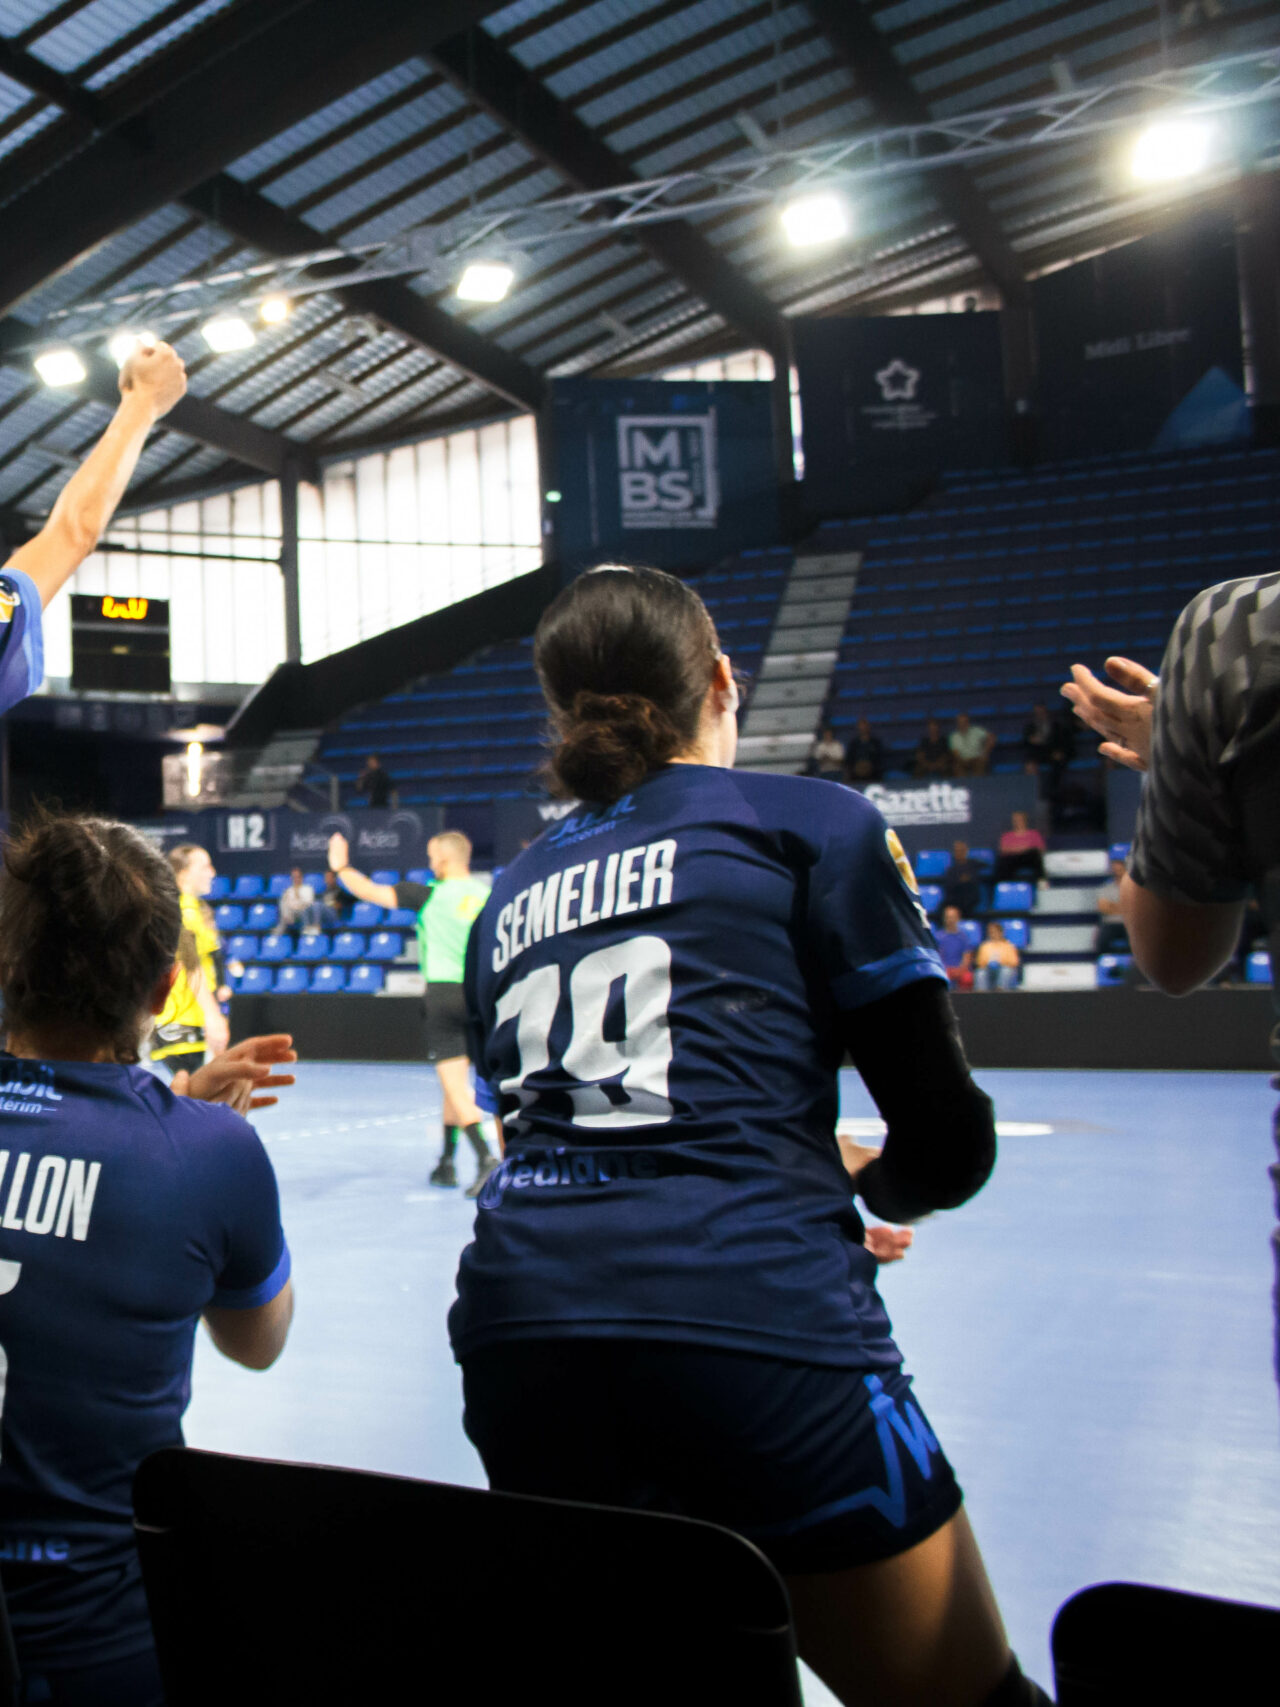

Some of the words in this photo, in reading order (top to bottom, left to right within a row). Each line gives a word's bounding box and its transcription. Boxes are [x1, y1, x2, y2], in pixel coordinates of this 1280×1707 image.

[620, 470, 694, 510] BS
[864, 784, 969, 813] Gazette
[492, 838, 678, 974] SEMELIER
